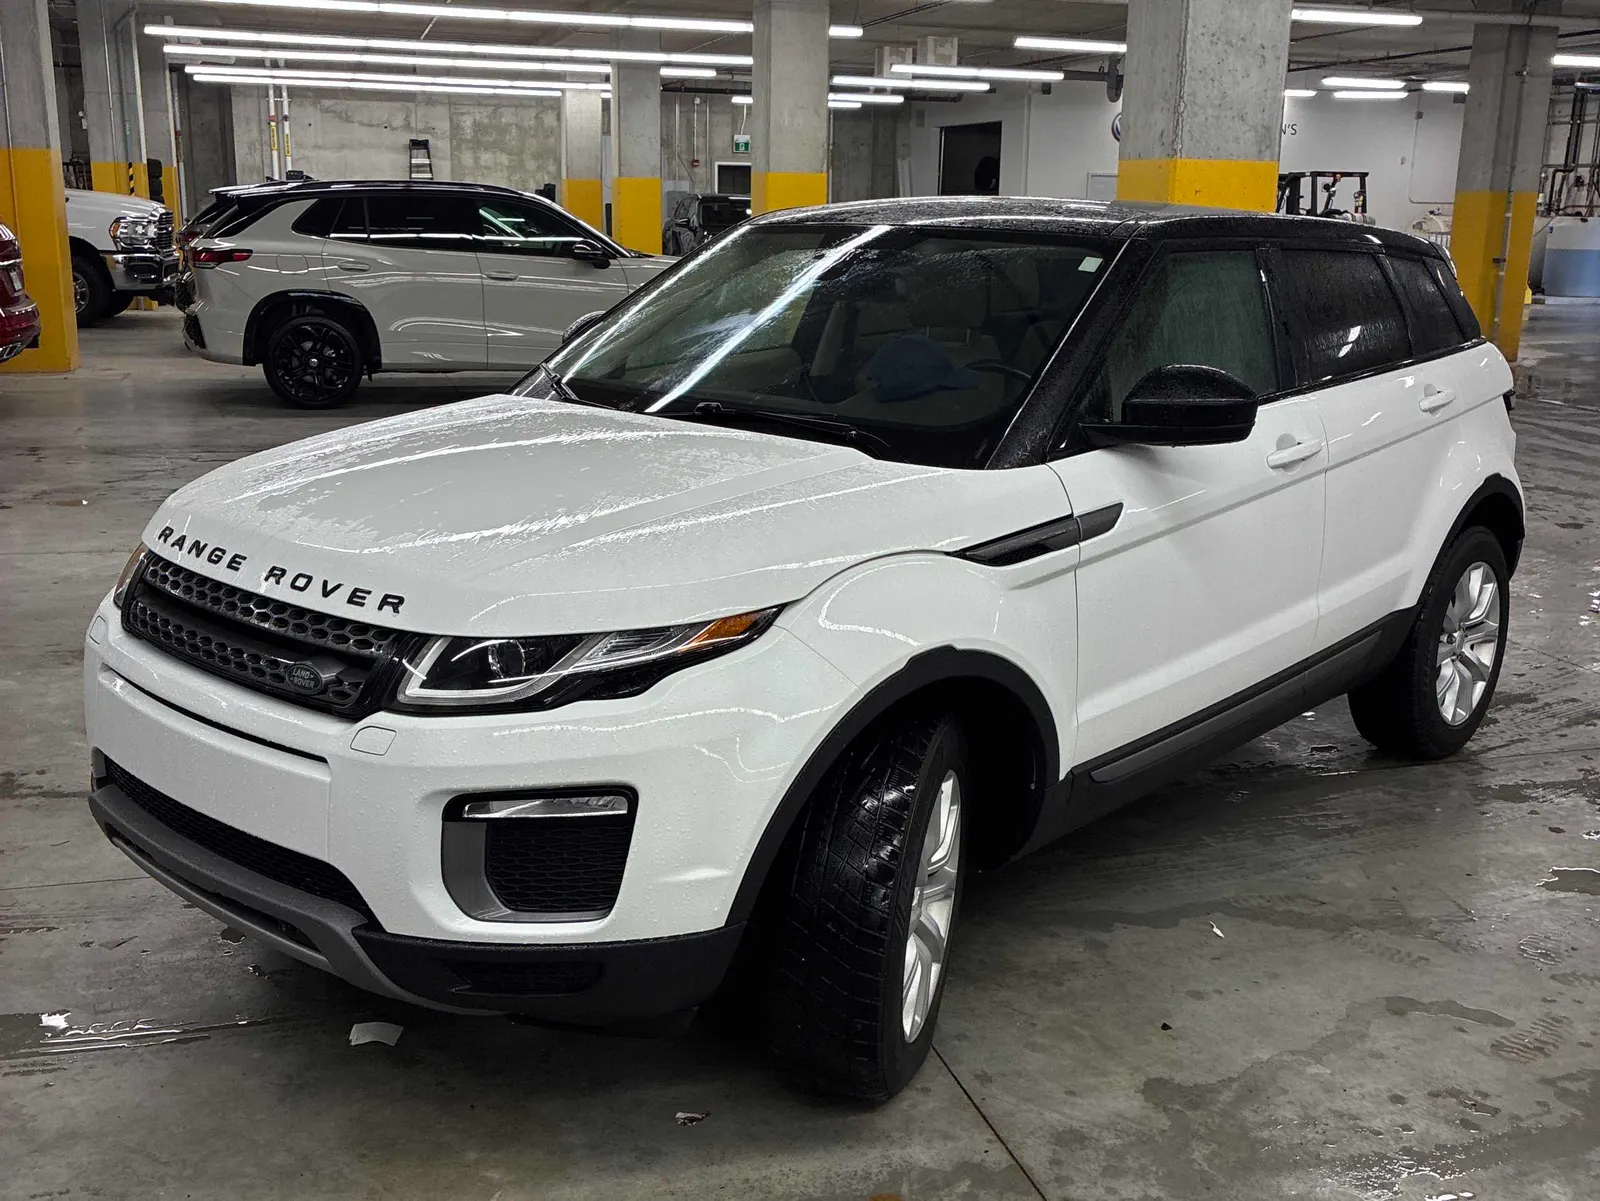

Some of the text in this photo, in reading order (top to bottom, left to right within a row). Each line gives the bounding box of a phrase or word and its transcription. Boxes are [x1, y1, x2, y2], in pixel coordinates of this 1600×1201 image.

[157, 525, 405, 614] RANGE ROVER
[292, 667, 310, 679] LAND
[293, 676, 315, 690] ROVER
